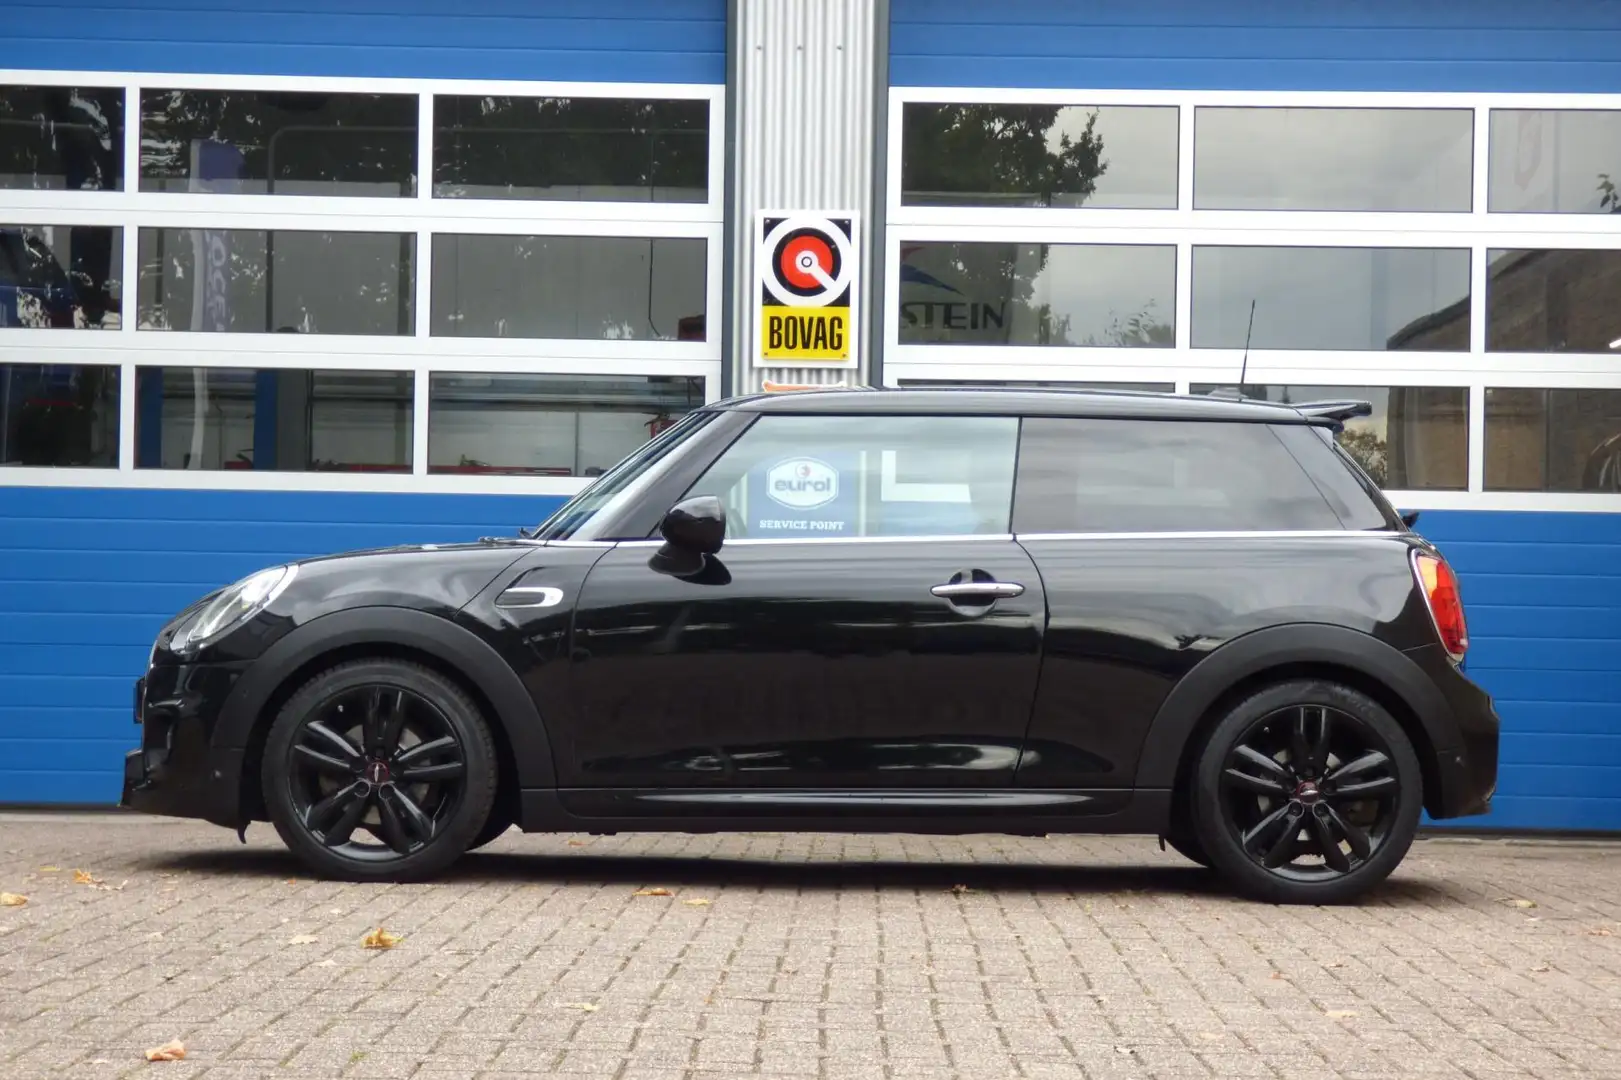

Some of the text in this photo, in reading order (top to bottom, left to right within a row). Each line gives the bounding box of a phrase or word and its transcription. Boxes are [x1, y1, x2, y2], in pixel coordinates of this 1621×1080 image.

[769, 315, 843, 351] BOVAG
[774, 477, 831, 492] eurol
[759, 519, 845, 531] SERVICE POINT
